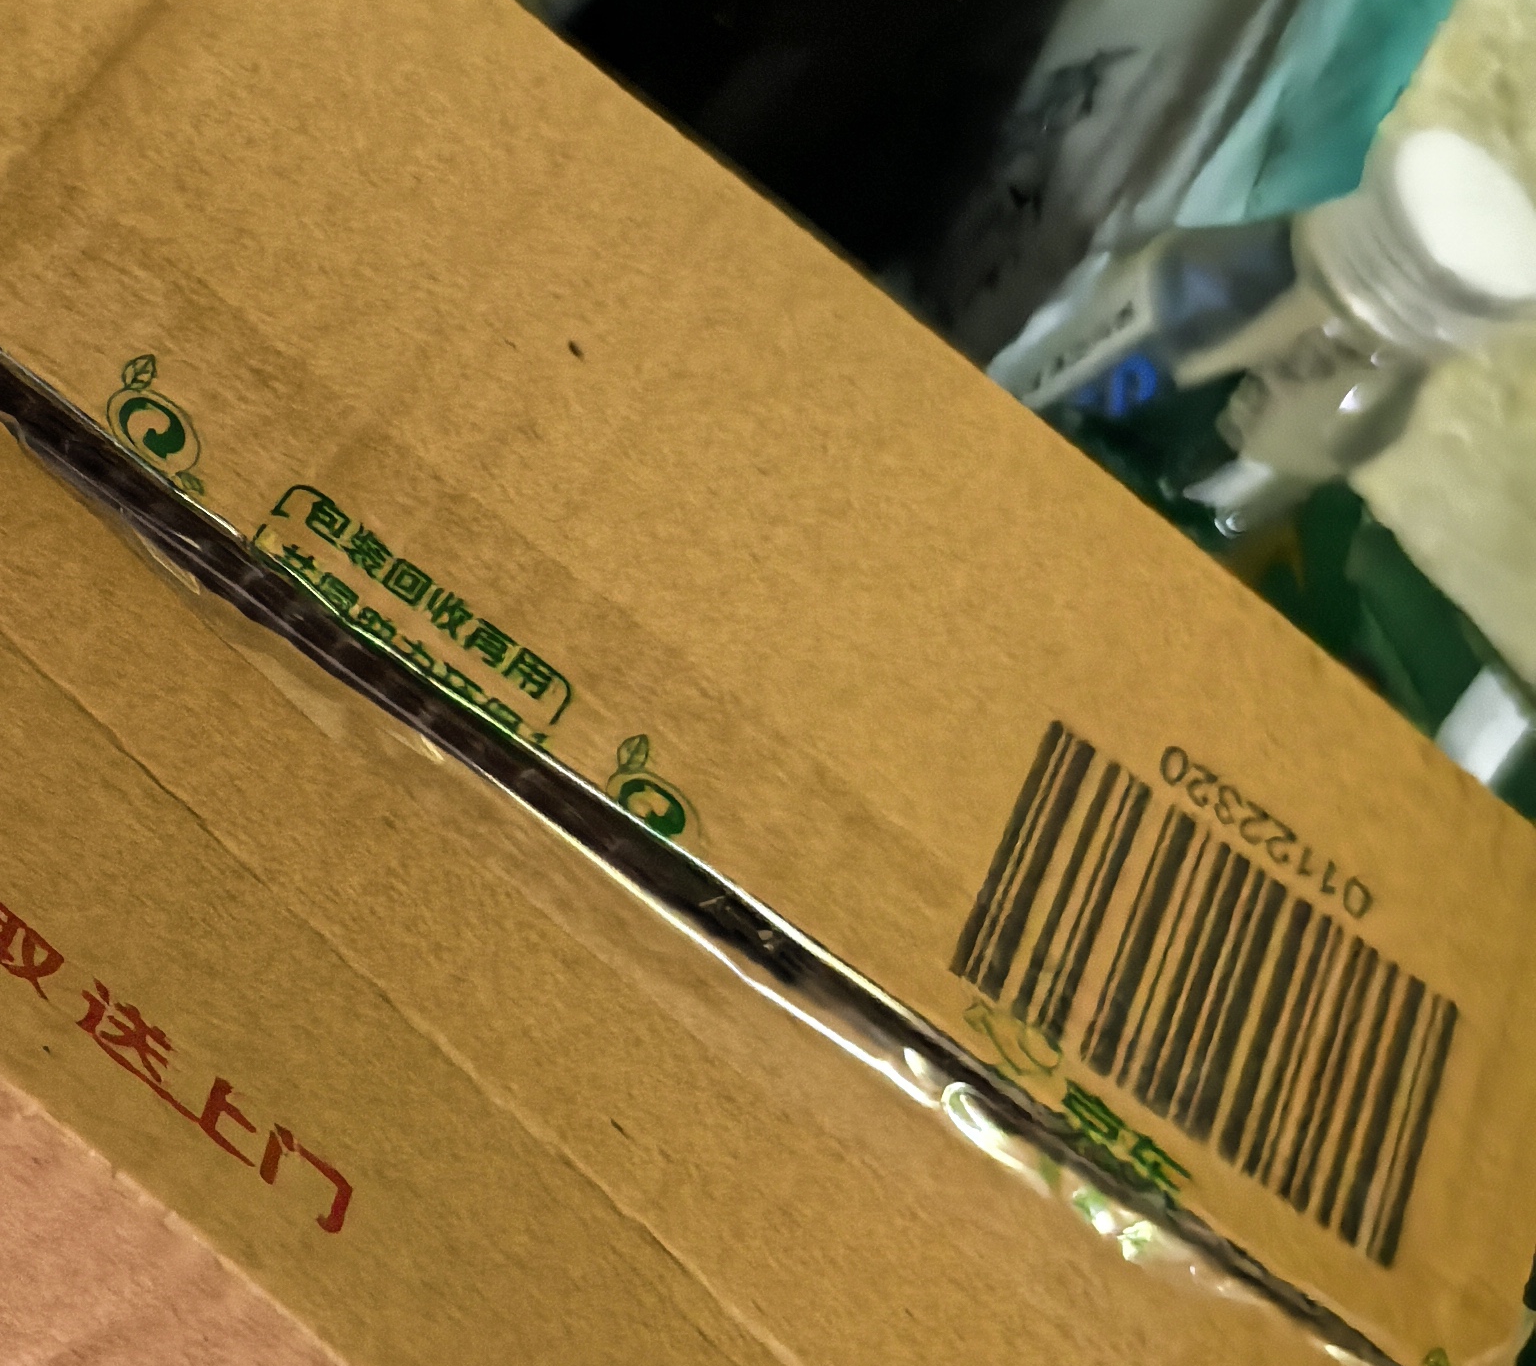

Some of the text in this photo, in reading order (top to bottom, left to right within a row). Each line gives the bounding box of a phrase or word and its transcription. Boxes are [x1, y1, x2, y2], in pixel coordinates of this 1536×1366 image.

[305, 500, 554, 701] 包装回收再用
[1159, 746, 1374, 920] 01122320
